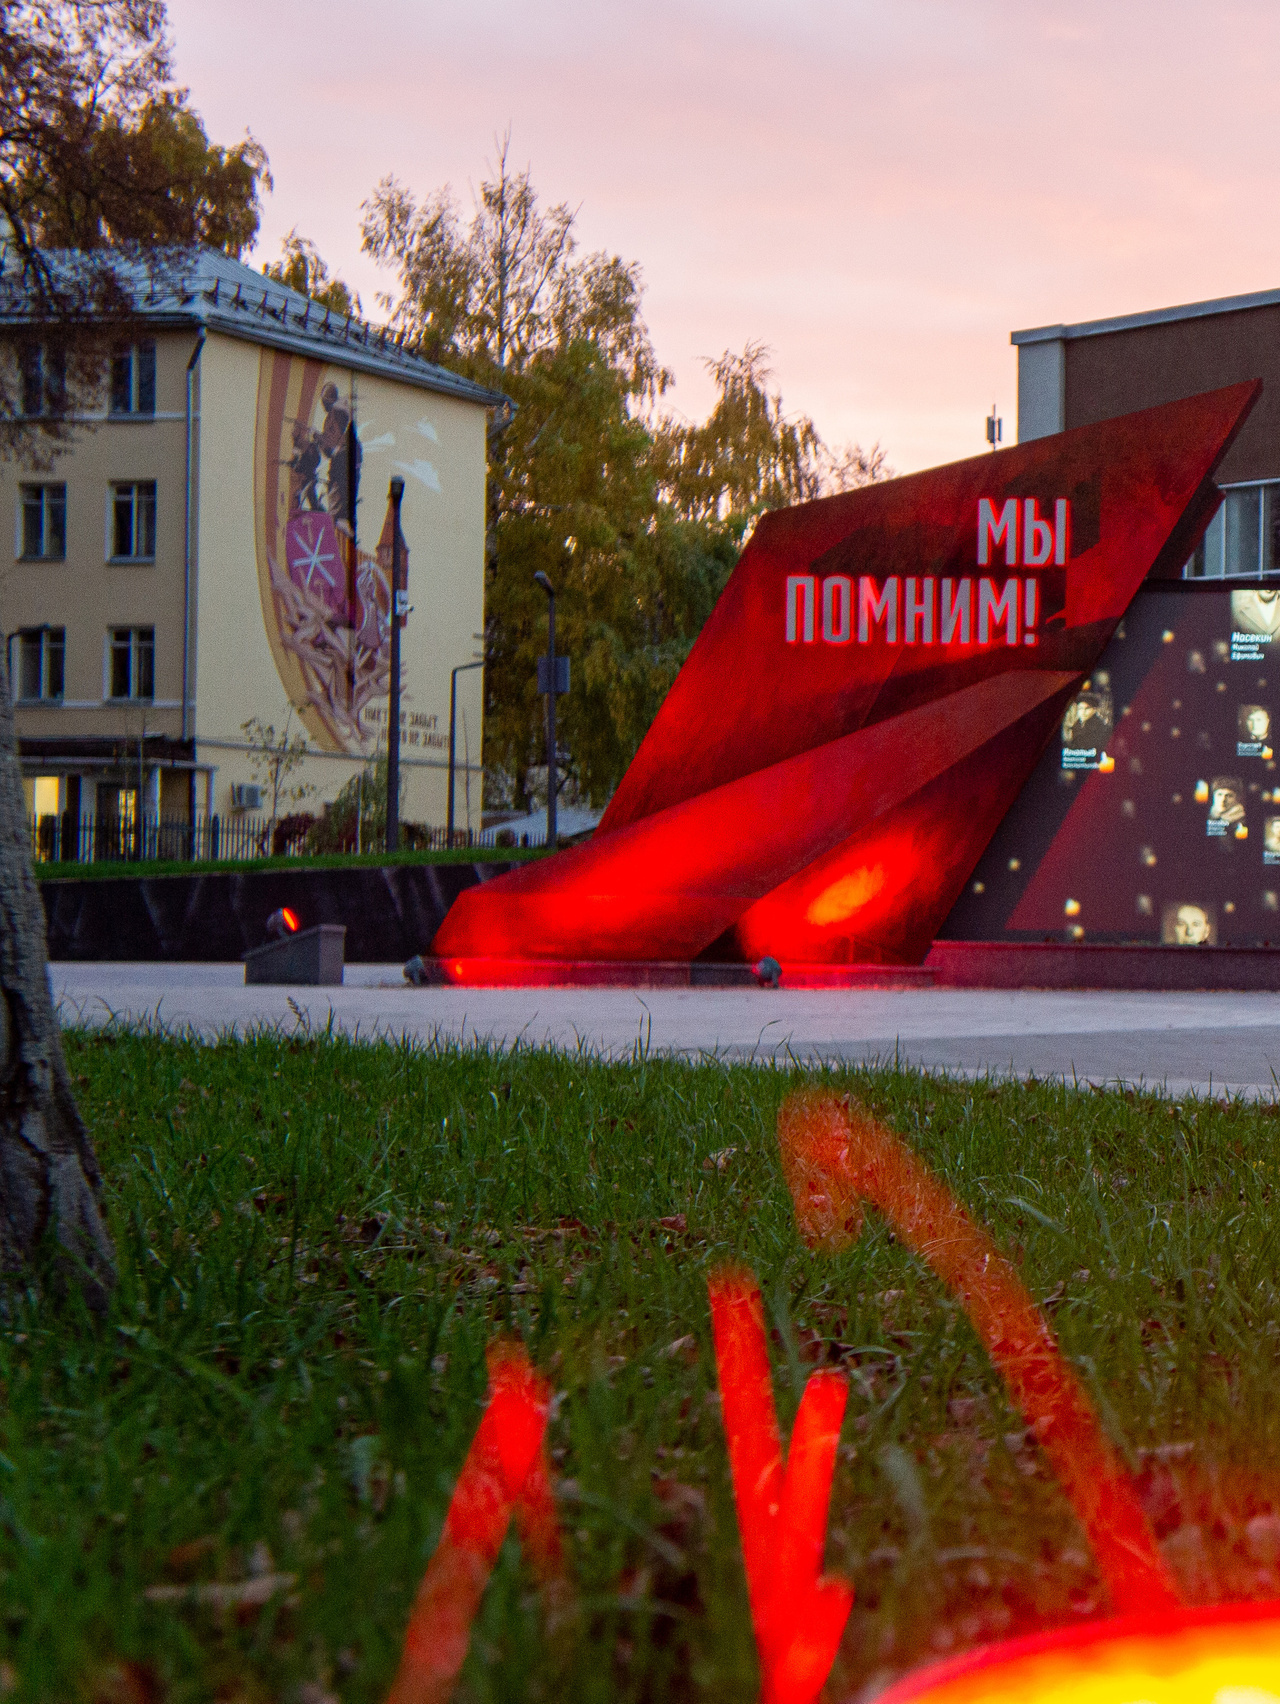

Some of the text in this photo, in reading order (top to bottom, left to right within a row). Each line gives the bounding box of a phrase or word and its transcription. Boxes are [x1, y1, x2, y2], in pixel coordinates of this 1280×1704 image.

[977, 498, 1067, 566] МЫ
[785, 575, 1037, 645] ПОМНИМ!
[1231, 631, 1273, 644] Насекин
